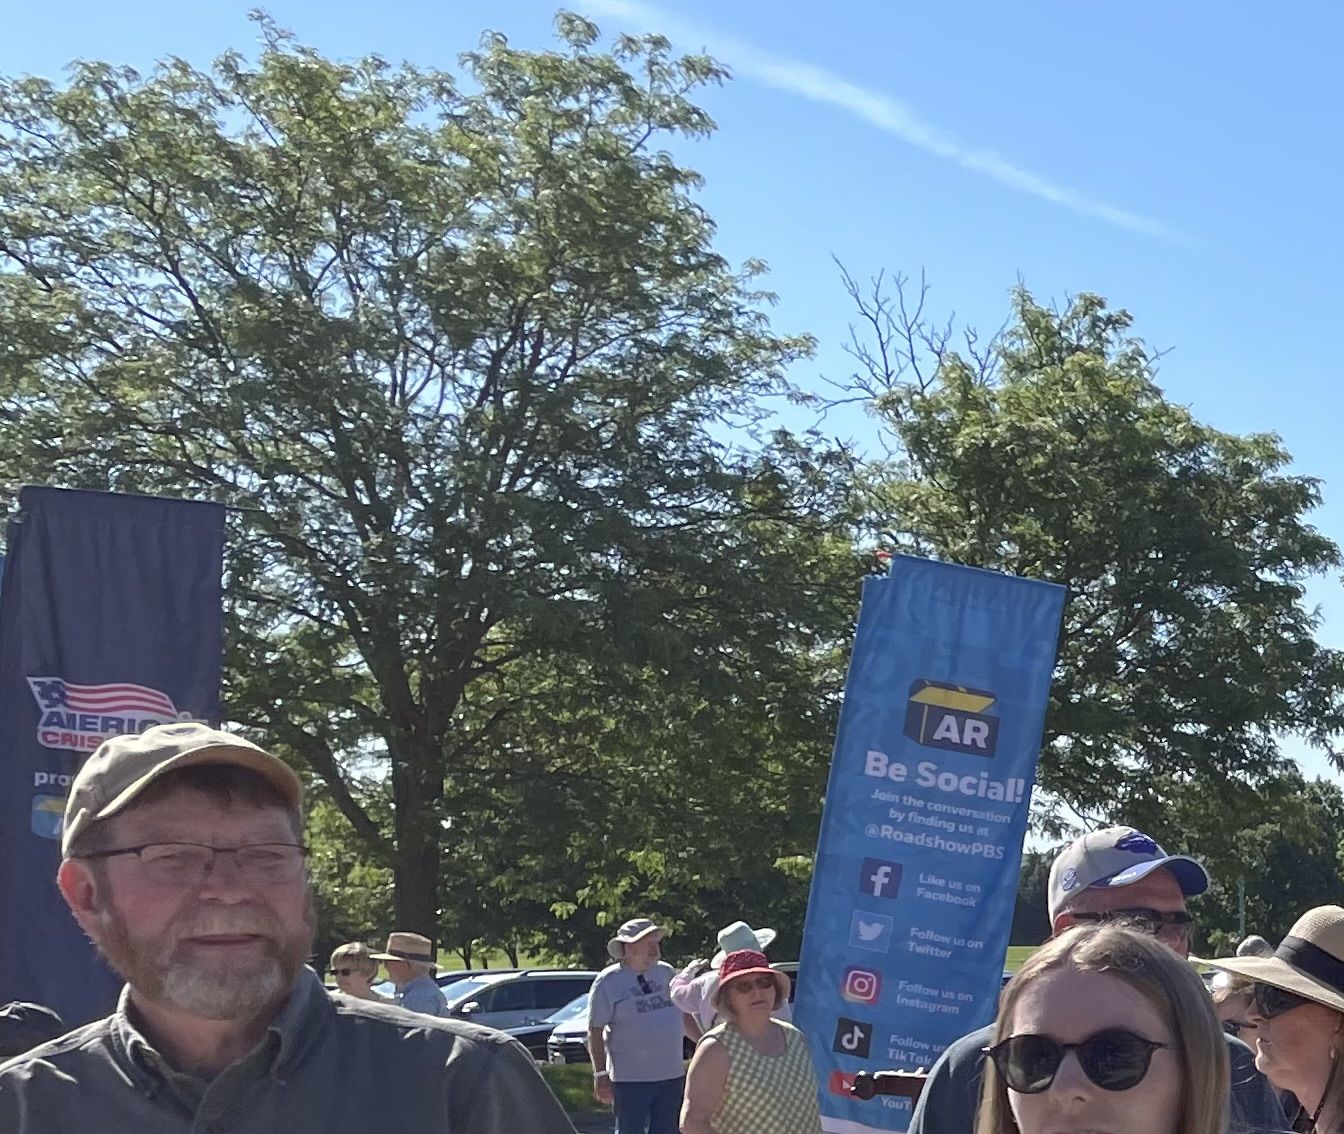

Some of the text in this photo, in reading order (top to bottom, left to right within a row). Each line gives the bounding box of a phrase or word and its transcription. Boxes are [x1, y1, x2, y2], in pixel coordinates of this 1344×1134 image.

[932, 714, 989, 749] AR
[34, 771, 72, 786] pro
[864, 750, 1026, 804] Be Social!
[870, 788, 1011, 824] Join the conversation
[888, 807, 990, 837] by finding us at
[865, 823, 1005, 860] @RoadshowPBS
[919, 872, 981, 893] Like us on
[916, 887, 977, 907] Facebook
[910, 927, 983, 949] Follow us on
[908, 941, 953, 958] Twitter
[898, 980, 973, 1002] Follow us on
[896, 994, 960, 1015] Instagram
[890, 1034, 930, 1052] Follow
[887, 1048, 933, 1065] TikTok
[880, 1095, 913, 1111] YouT
